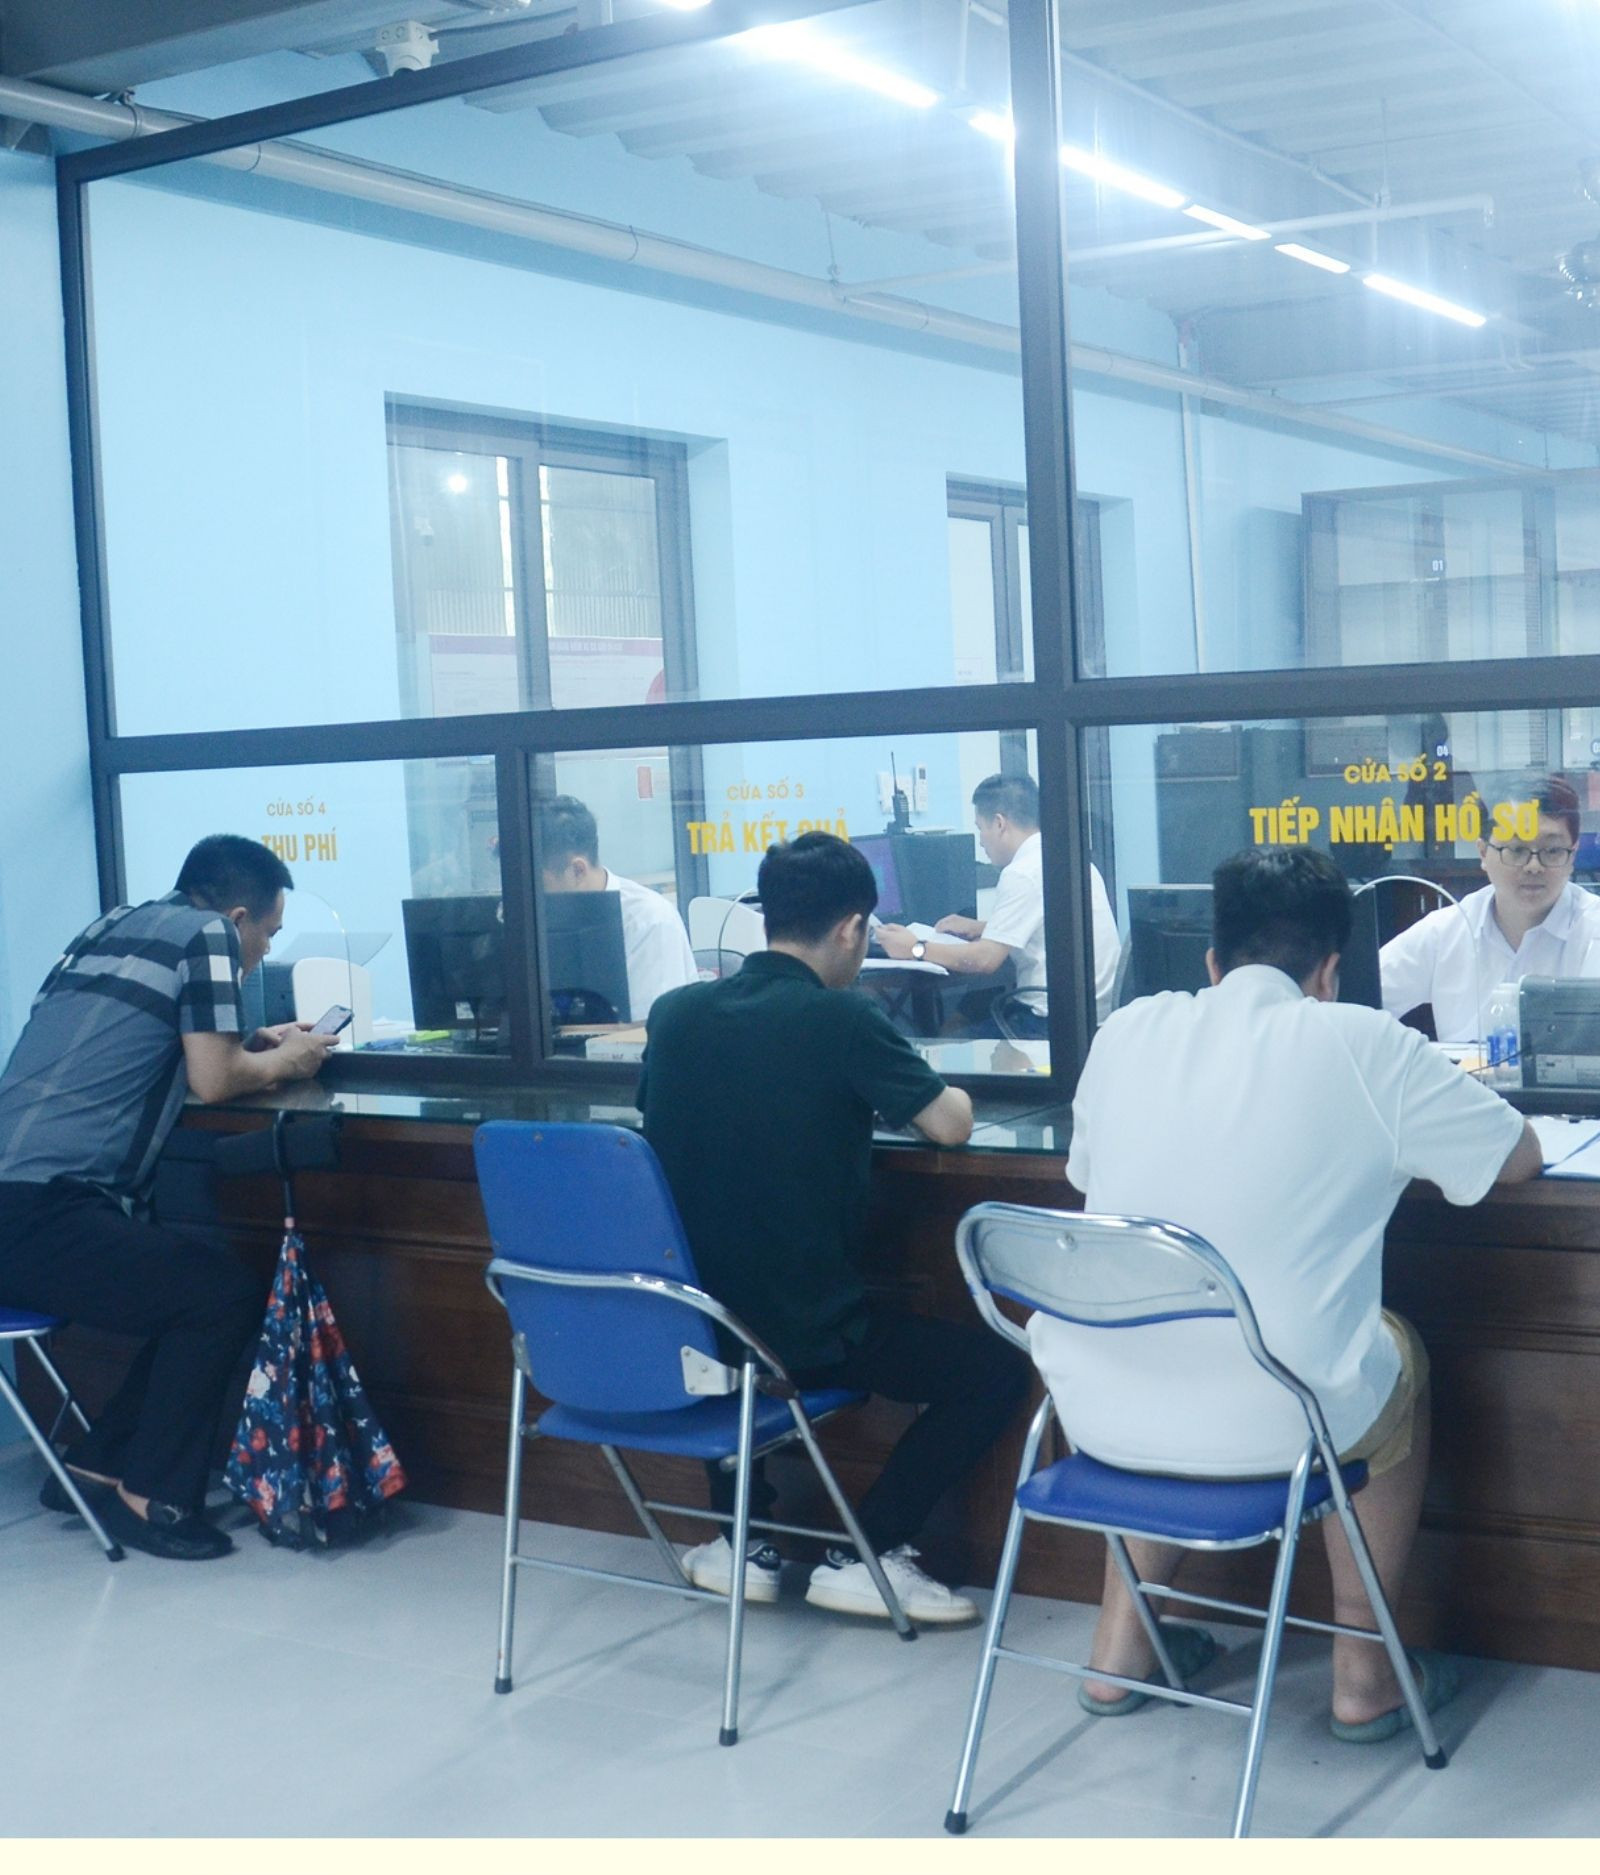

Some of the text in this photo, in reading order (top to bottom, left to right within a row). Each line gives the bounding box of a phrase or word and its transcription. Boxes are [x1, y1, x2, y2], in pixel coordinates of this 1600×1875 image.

[1432, 560, 1444, 572] 01
[1436, 745, 1449, 757] 04
[1344, 753, 1447, 784] CỬA SỐ 2
[727, 776, 804, 801] CỬA SỐ 3
[266, 794, 326, 816] CỬA SỐ 4
[686, 810, 735, 854] TRẢ
[743, 810, 788, 853] KẾT
[1249, 791, 1540, 851] TIẾP NHẬN HỒ SƠ
[261, 826, 337, 862] THU PHÍ
